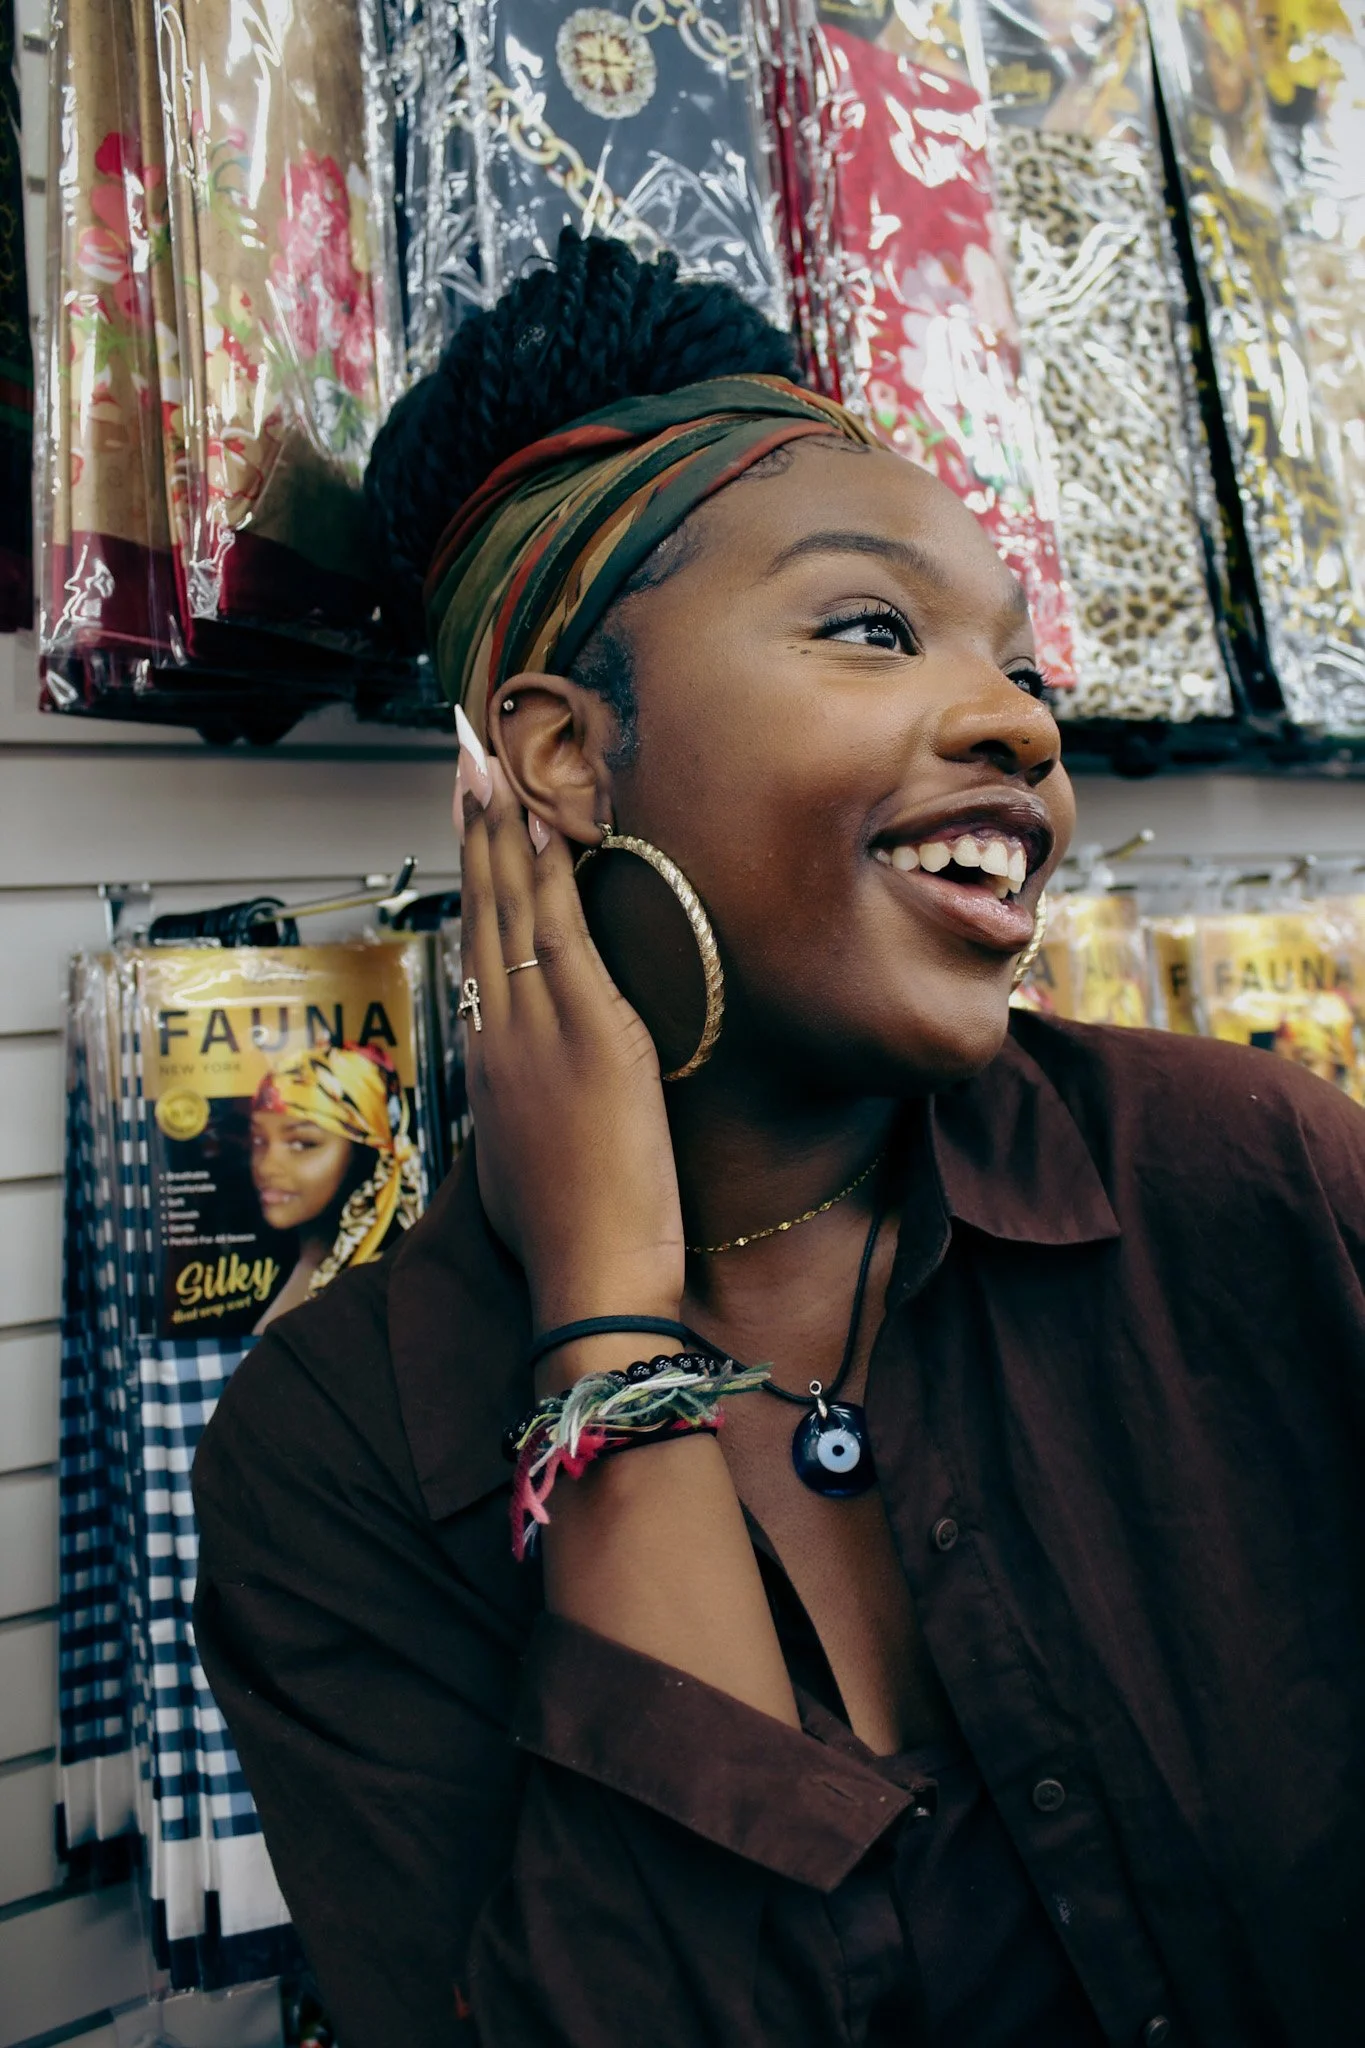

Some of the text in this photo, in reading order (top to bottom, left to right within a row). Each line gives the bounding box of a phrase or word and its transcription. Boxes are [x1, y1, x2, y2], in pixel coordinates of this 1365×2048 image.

[158, 1001, 398, 1056] FAUNA
[158, 1061, 241, 1076] NEW YORK
[176, 1252, 280, 1306] Silky
